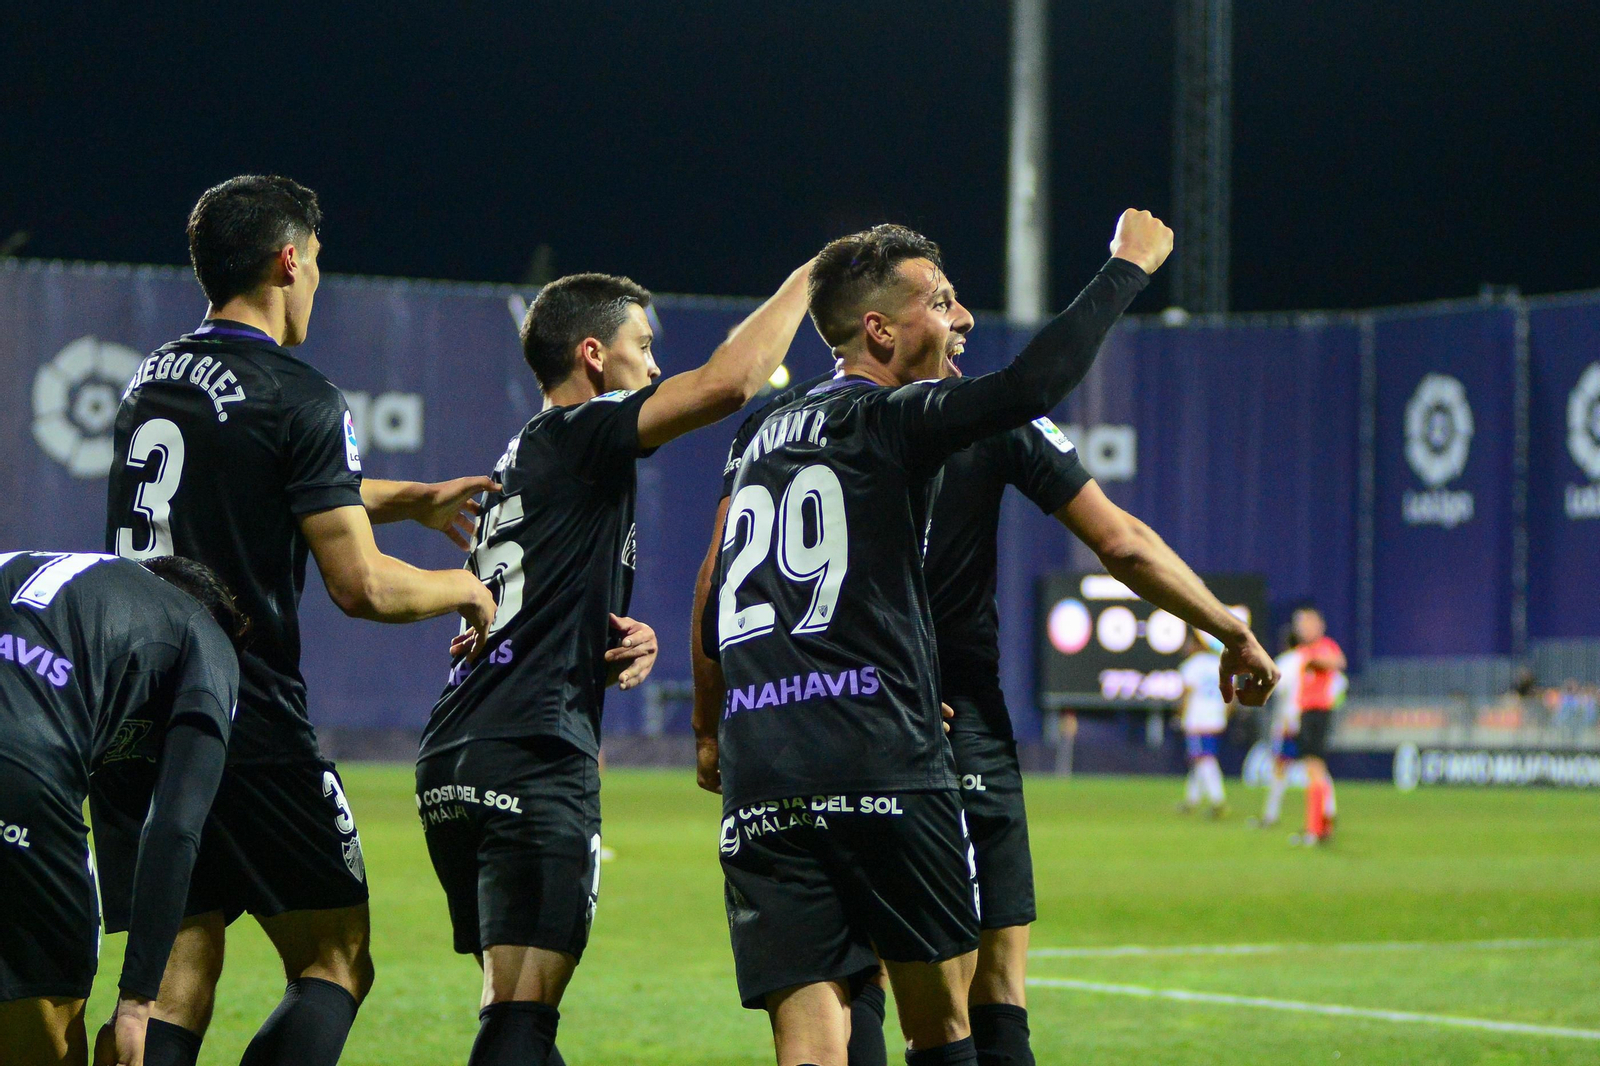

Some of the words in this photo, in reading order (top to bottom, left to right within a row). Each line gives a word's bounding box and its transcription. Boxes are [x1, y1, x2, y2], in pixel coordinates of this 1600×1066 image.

[189, 355, 246, 422] GLEZ.
[115, 418, 185, 559] 3
[719, 464, 848, 651] 29
[724, 666, 880, 720] NAHAVIS
[322, 771, 354, 834] 3
[456, 785, 480, 804] DEL
[482, 790, 523, 814] SOL
[811, 795, 854, 812] DEL
[859, 796, 903, 815] SOL
